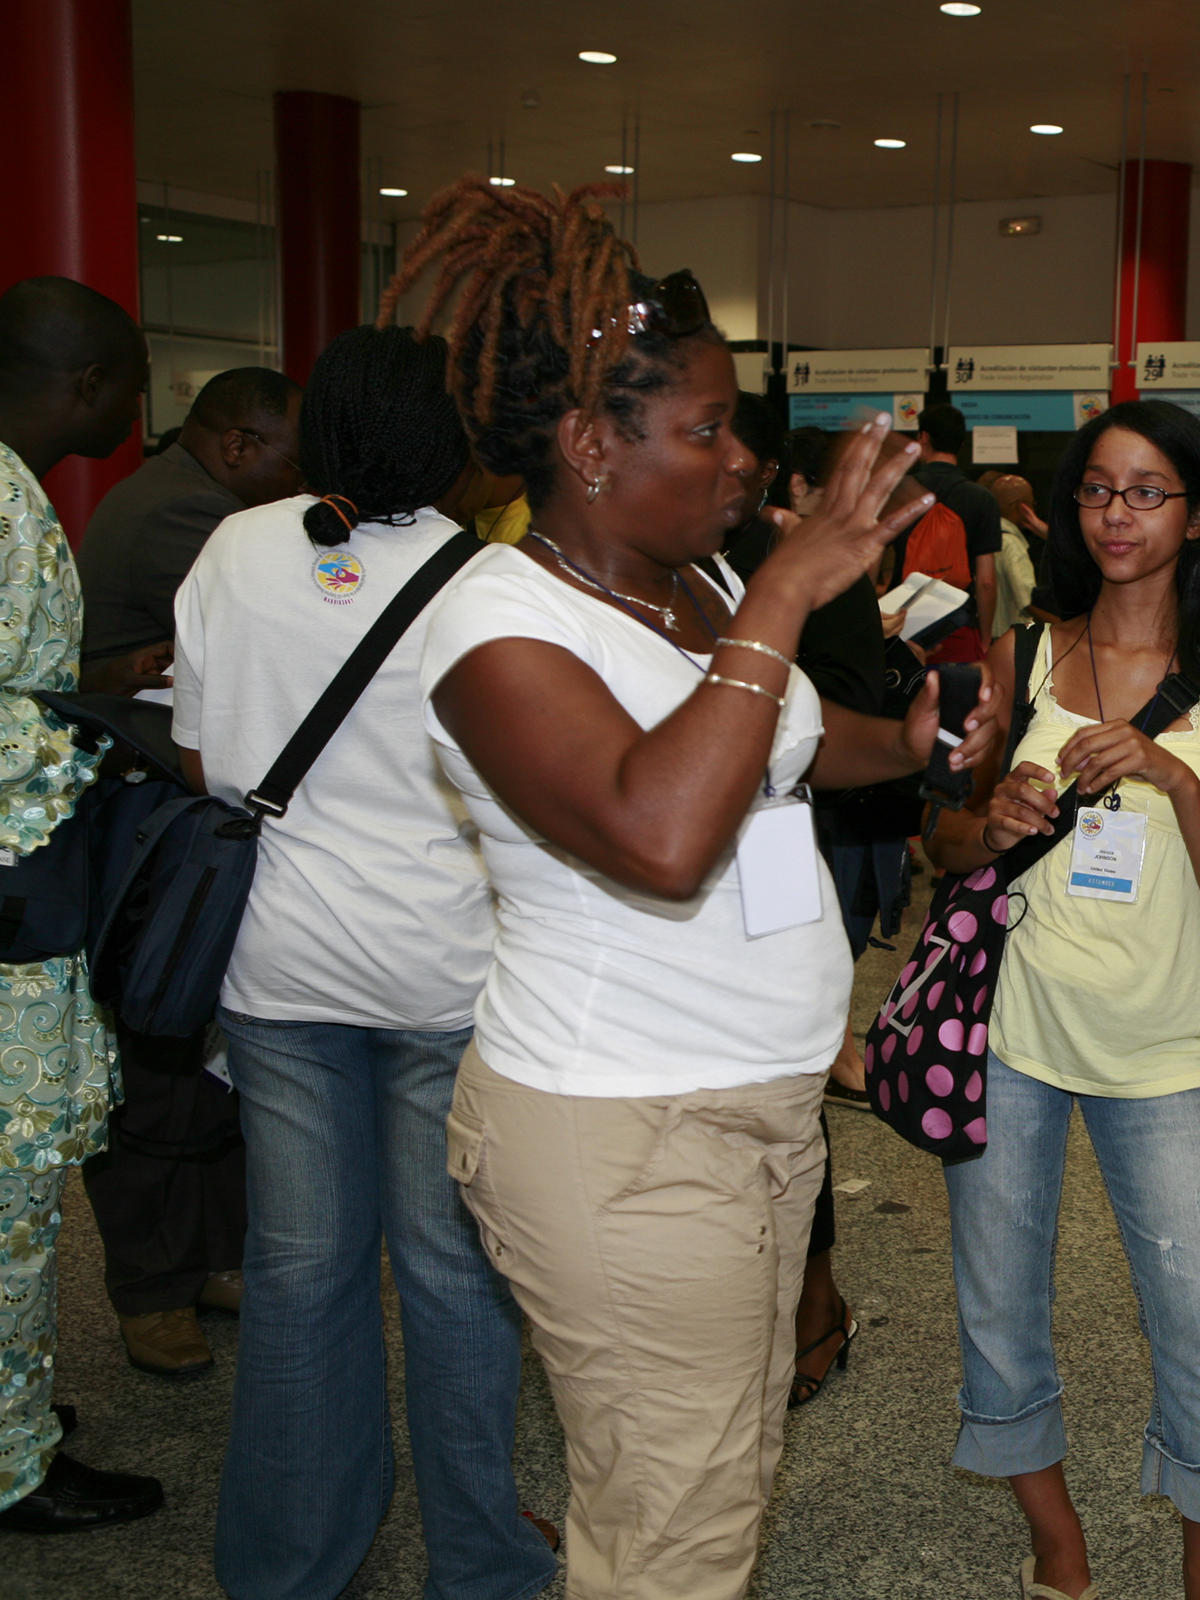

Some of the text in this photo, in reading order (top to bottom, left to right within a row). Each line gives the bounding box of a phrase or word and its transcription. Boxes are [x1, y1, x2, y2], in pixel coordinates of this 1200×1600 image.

[954, 371, 968, 384] 30
[1143, 369, 1159, 381] 29
[1088, 878, 1115, 887] ATTENDEE
